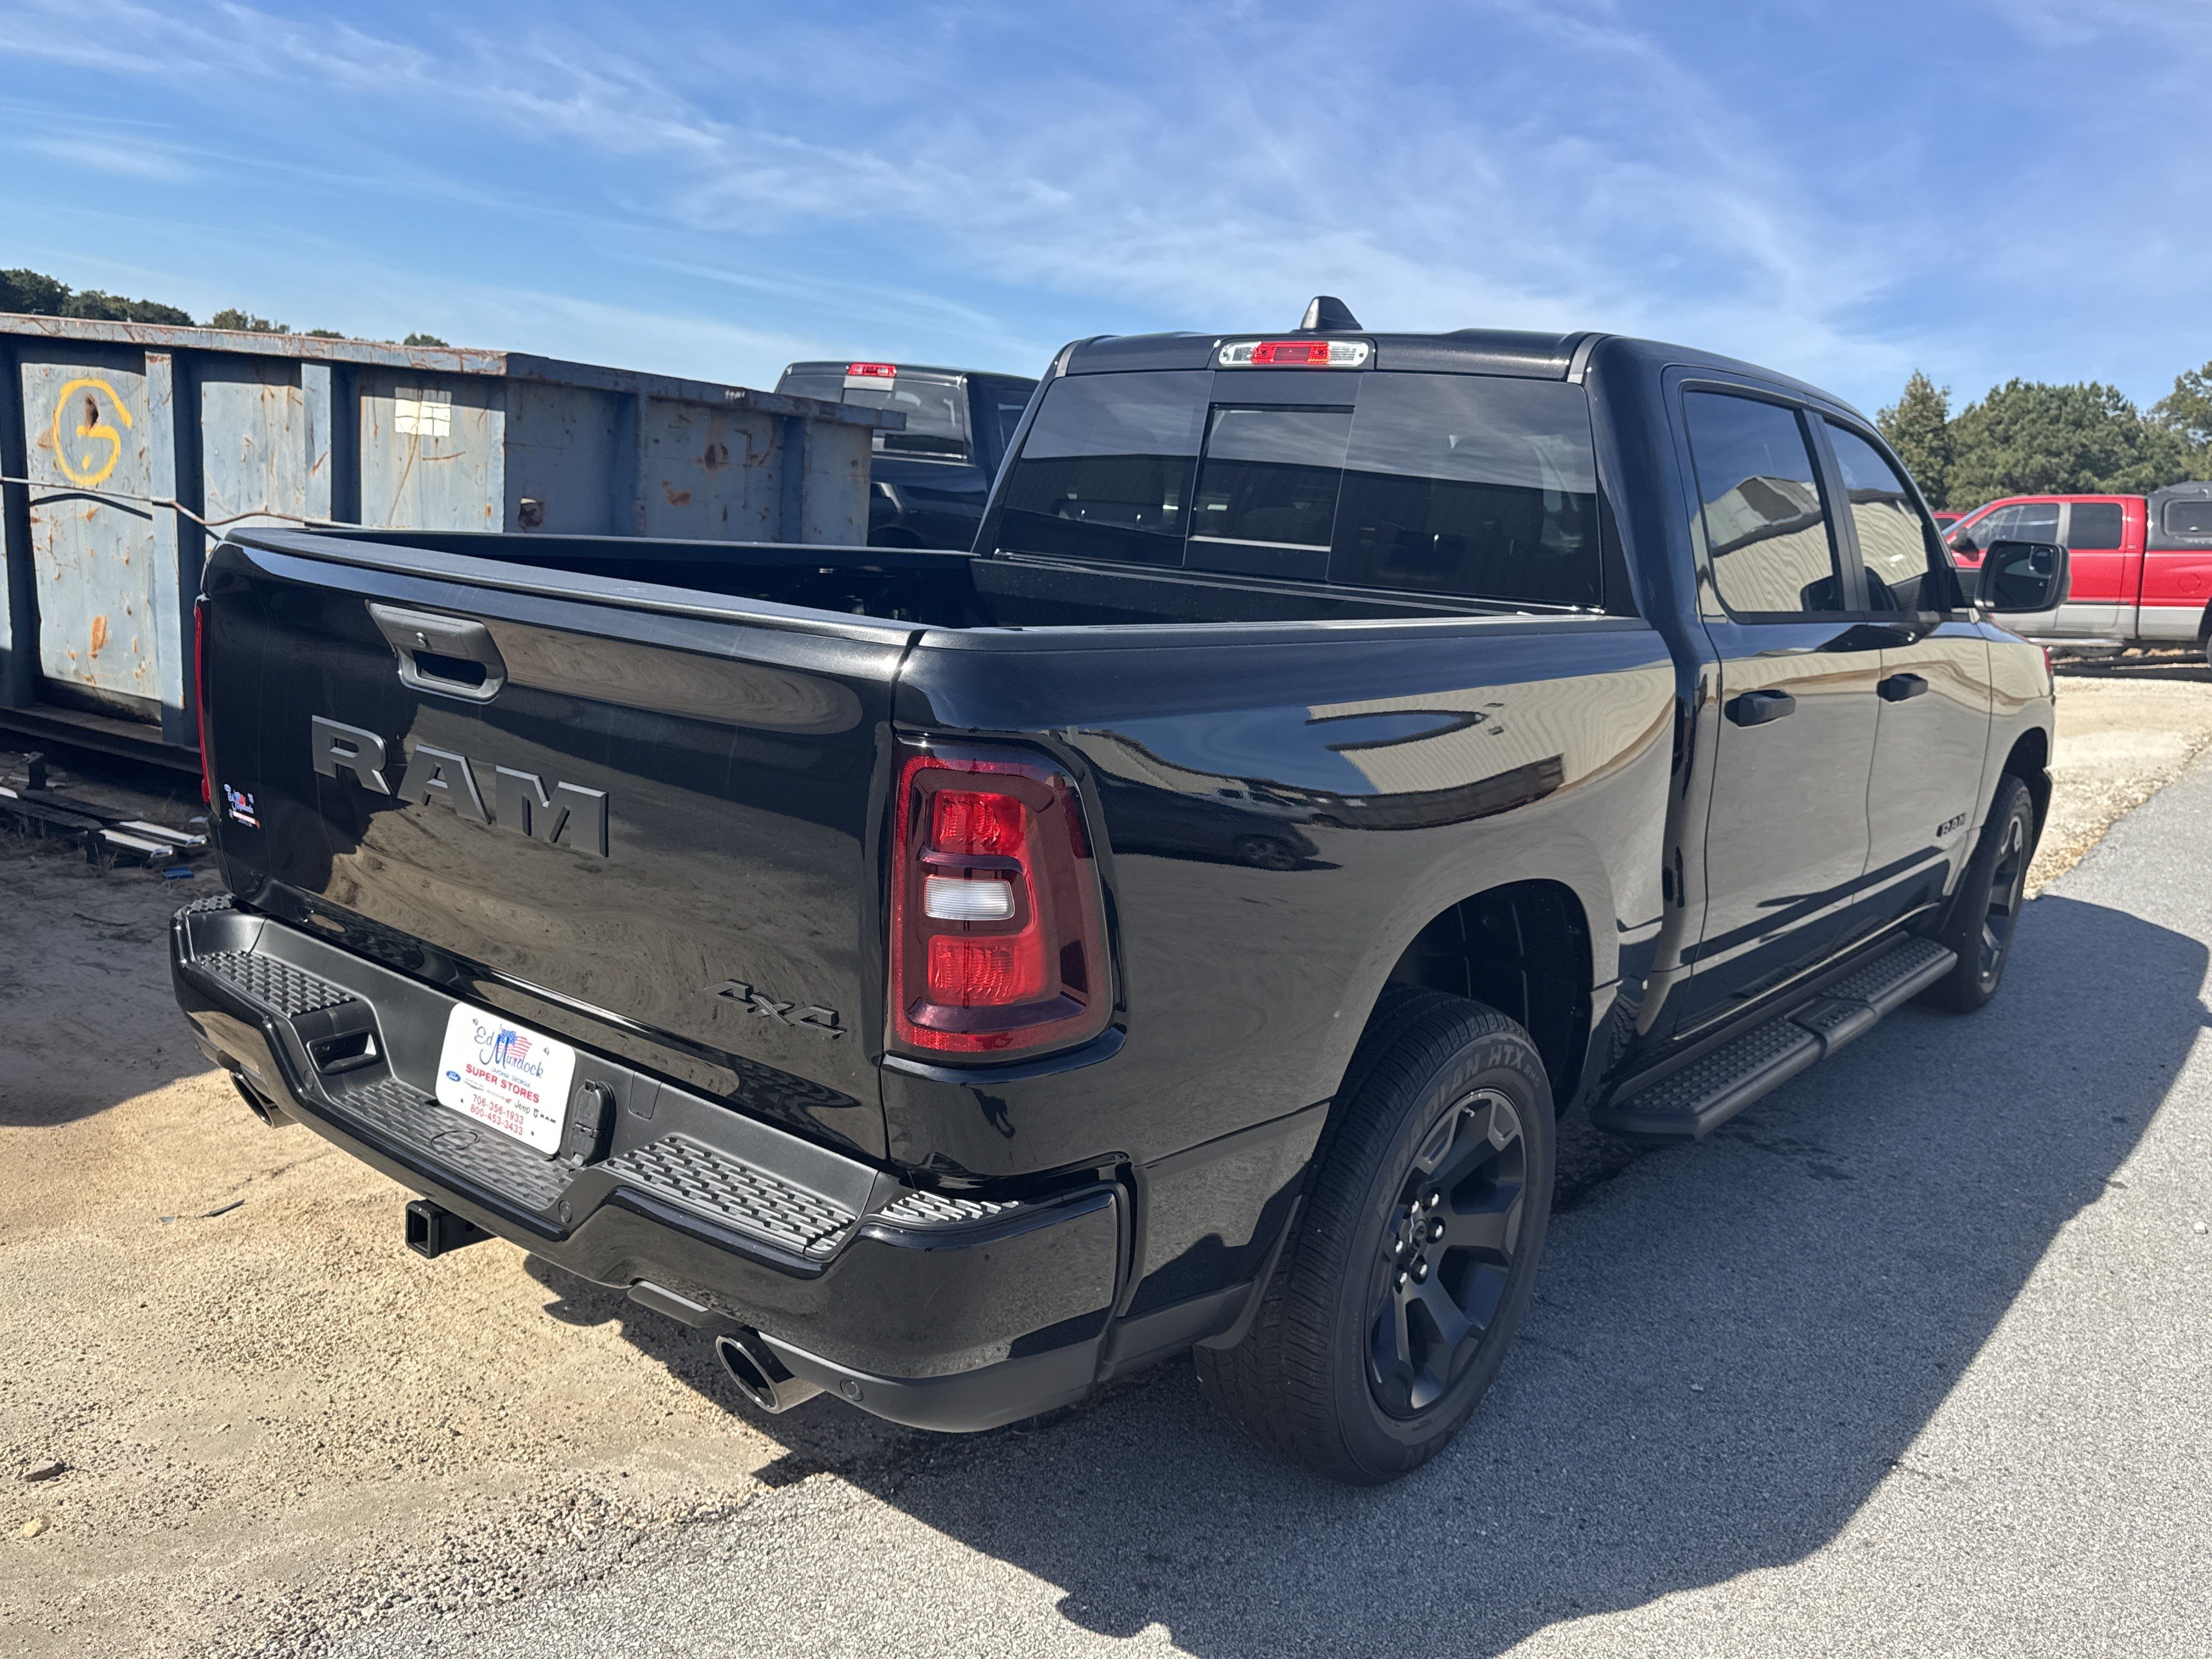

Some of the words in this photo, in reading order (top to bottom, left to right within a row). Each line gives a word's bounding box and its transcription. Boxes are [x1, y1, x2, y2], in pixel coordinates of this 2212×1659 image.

[312, 715, 609, 857] RAM
[473, 1025, 495, 1046] Ed
[479, 1034, 544, 1078] Murdock
[1488, 1044, 1526, 1069] HTX
[466, 1064, 498, 1085] SUPER
[500, 1079, 540, 1103] STORES
[470, 1104, 523, 1136] 800-453-3433
[473, 1094, 524, 1125] 706-356-1933
[515, 1100, 530, 1114] Jeep
